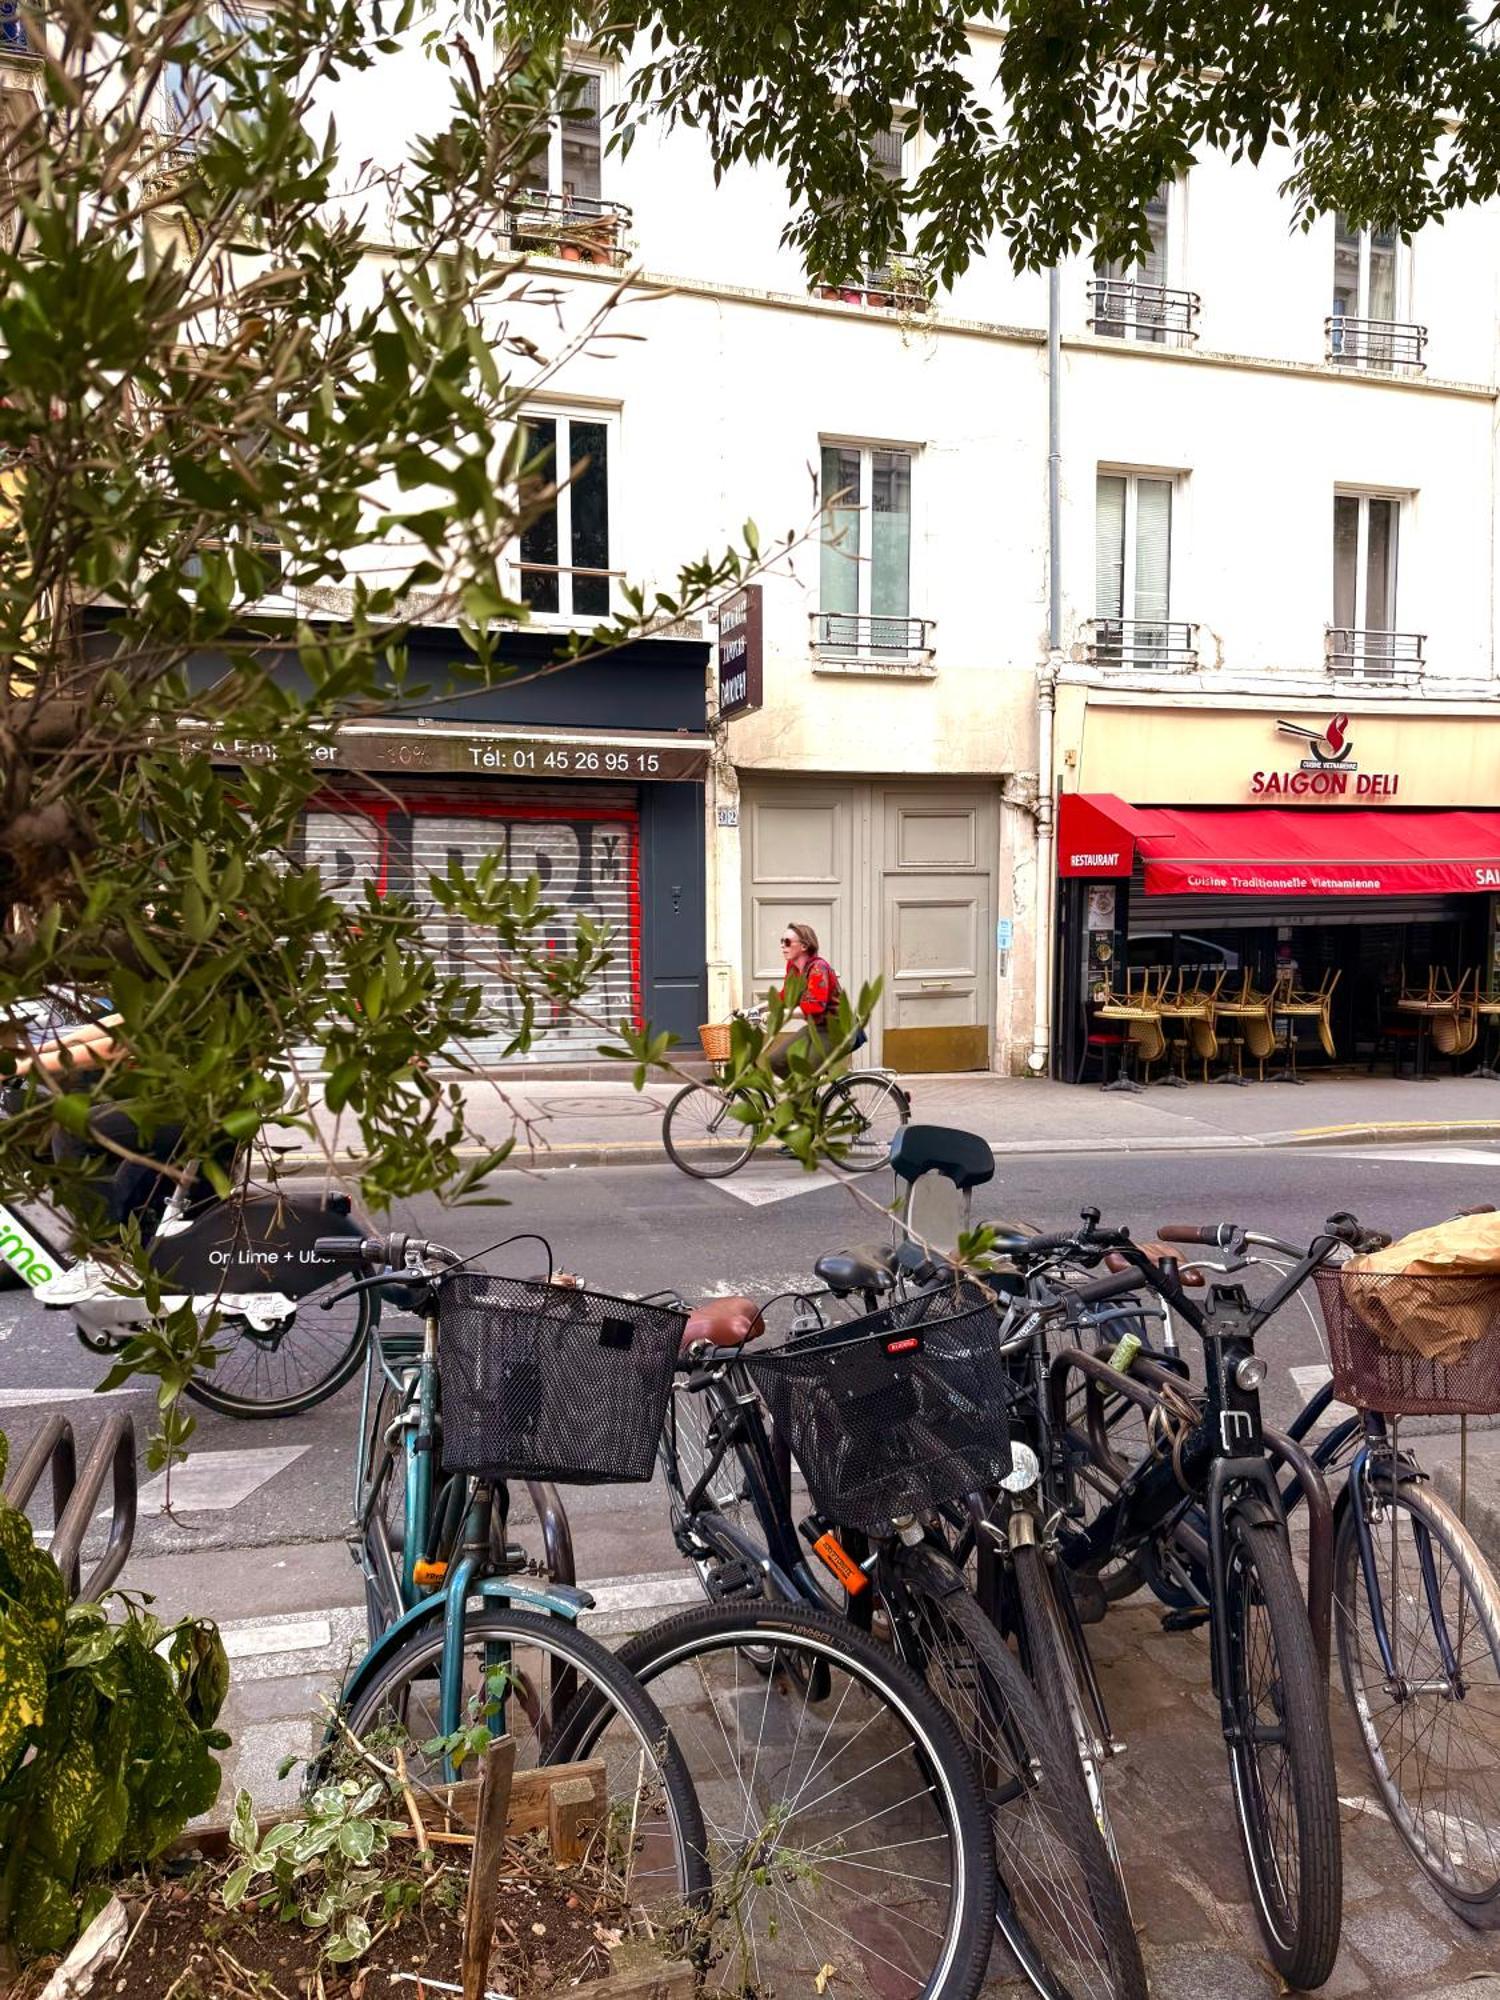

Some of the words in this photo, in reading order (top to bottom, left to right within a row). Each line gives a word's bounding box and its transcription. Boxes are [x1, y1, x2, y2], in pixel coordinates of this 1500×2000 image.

[468, 745, 506, 767] Tél:
[513, 750, 535, 768] 01
[543, 751, 569, 769] 45
[575, 752, 599, 770] 26
[605, 753, 629, 771] 95
[636, 754, 659, 772] 15
[1252, 771, 1348, 795] SAIGON
[1356, 773, 1399, 795] DELI
[1070, 853, 1119, 867] RESTAURANT
[1187, 875, 1227, 887] Cuisine
[1231, 876, 1307, 888] Traditionnelle
[1311, 877, 1381, 889] Vietnamienne
[1475, 868, 1500, 885] SAI
[239, 1249, 279, 1264] Lime
[299, 1250, 336, 1264] Ub
[791, 1623, 834, 1646] TERRAIN
